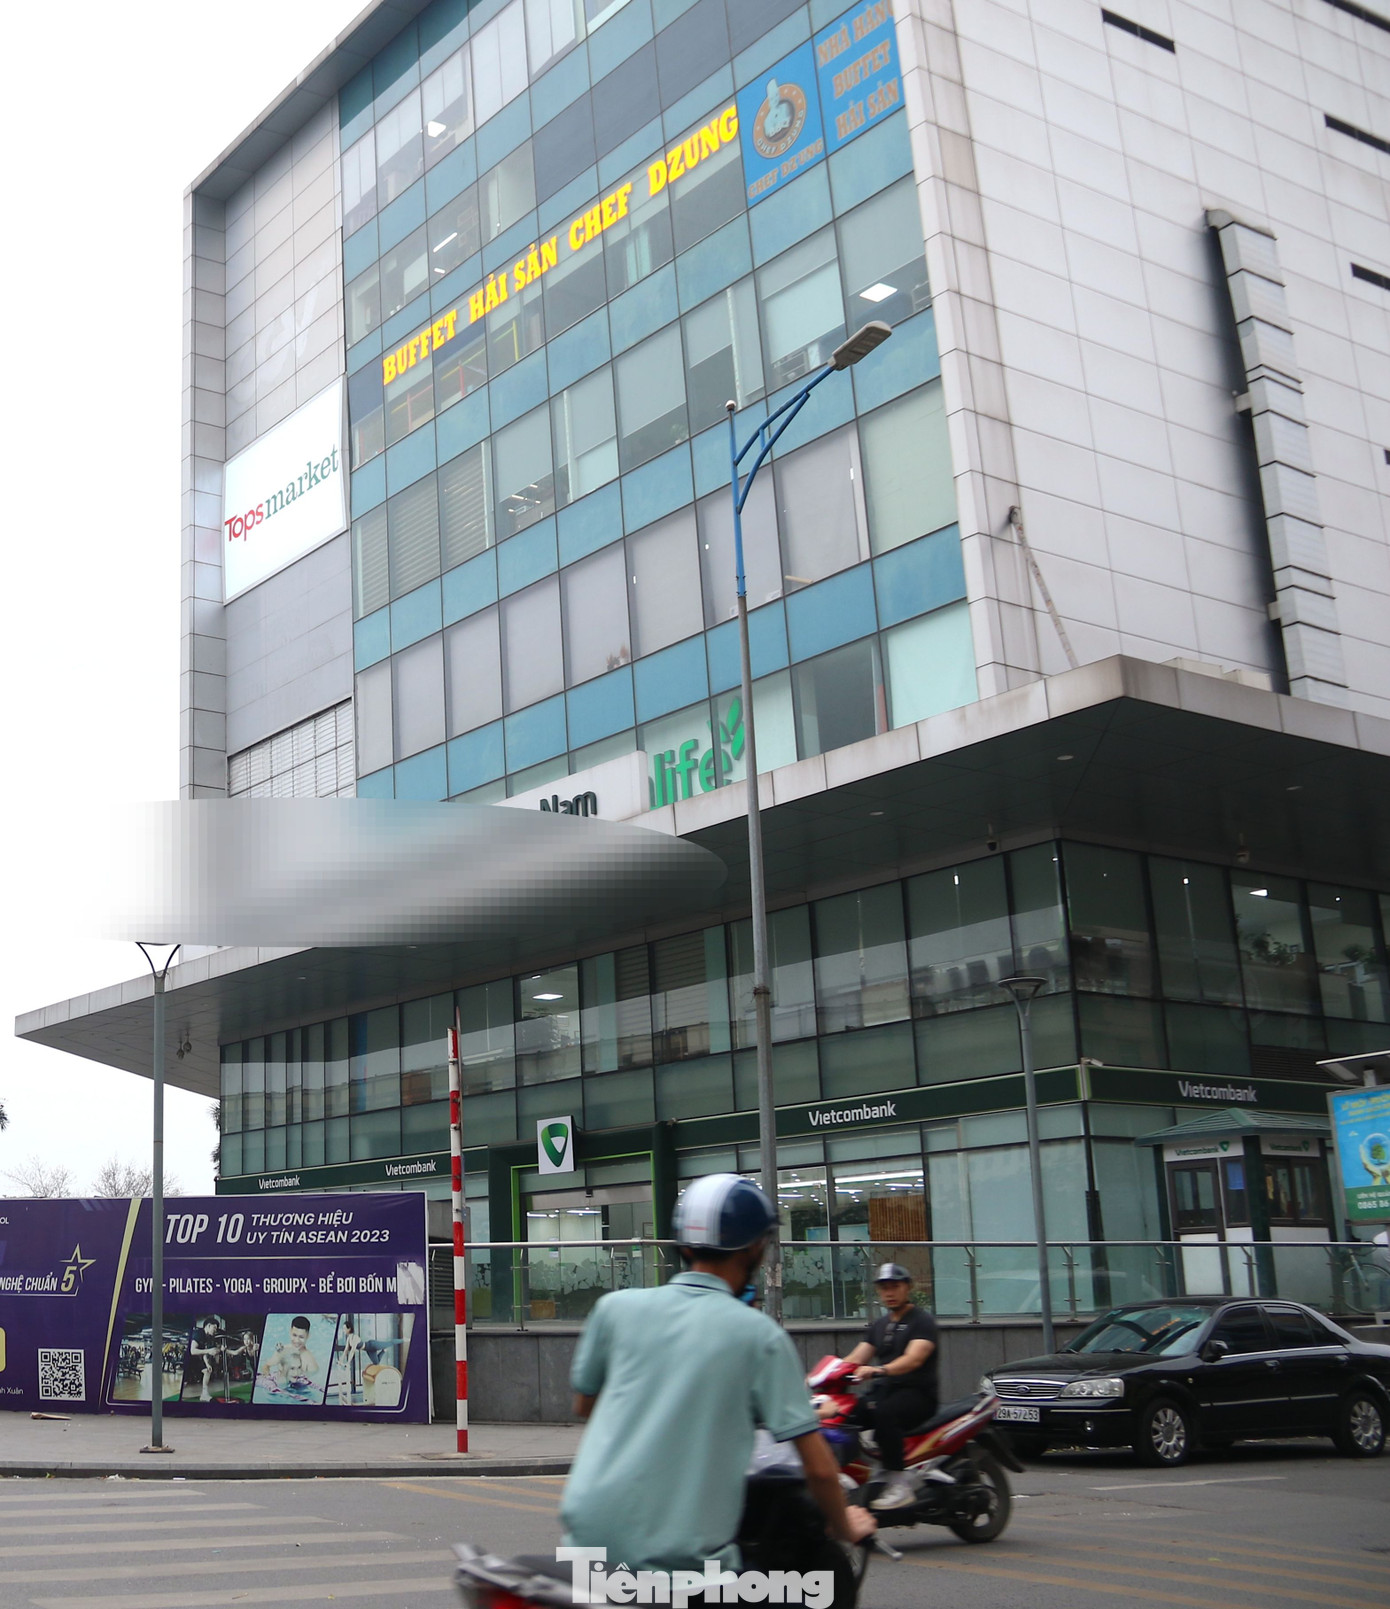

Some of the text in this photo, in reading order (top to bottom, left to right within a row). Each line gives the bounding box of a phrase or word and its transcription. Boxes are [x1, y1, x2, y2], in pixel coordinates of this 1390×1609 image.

[832, 38, 890, 99] BUFFET
[748, 168, 778, 199] CHEF
[383, 104, 739, 386] BUFFET HẢI SẢN CHEF DZUNG
[649, 739, 733, 811] life
[1178, 1080, 1257, 1102] Vietcombank
[808, 1100, 896, 1127] Vietcombank
[385, 1159, 437, 1177] Vietcombank
[258, 1174, 300, 1190] Vietcombank
[165, 1213, 245, 1243] TOP 10
[251, 1209, 353, 1227] THƯƠNG HIỆU
[246, 1228, 390, 1244] UY TÍN ASEAN 2023
[61, 1266, 77, 1292] 5
[169, 1277, 213, 1293] PILATES
[223, 1277, 252, 1293] YOGA
[263, 1277, 307, 1293] GROUPX
[359, 1272, 383, 1293] BỐN
[386, 1277, 397, 1293] M
